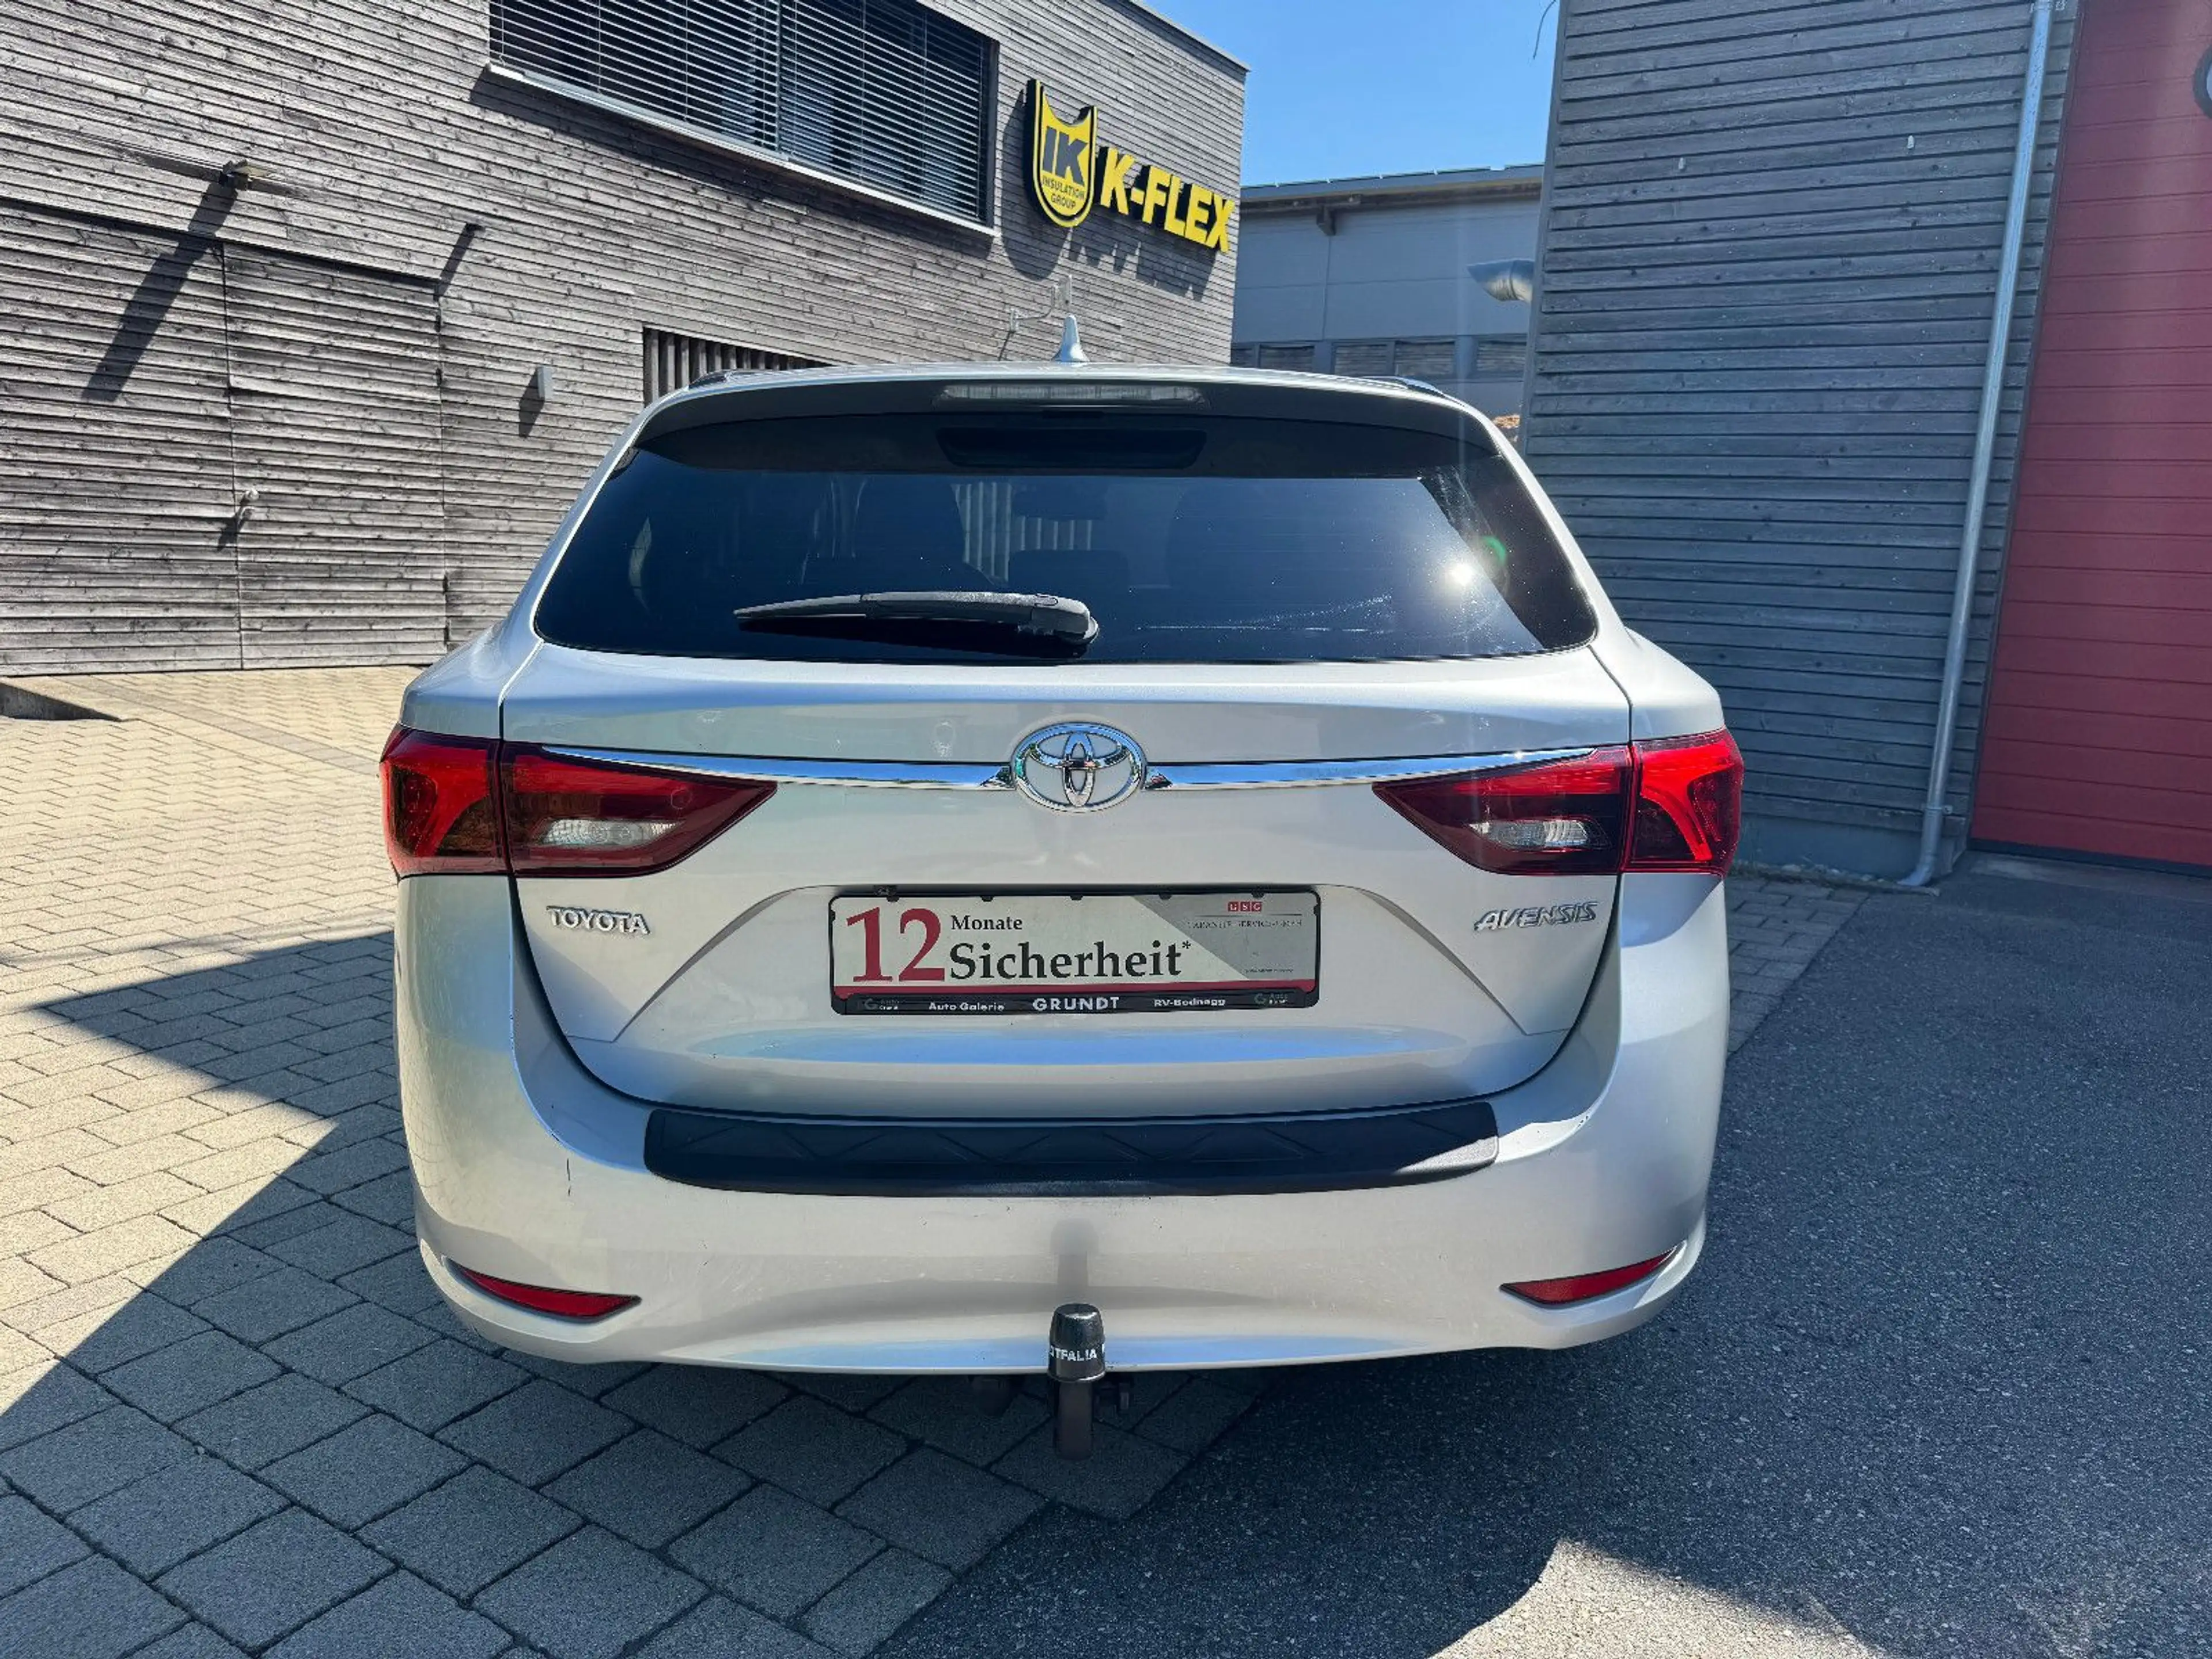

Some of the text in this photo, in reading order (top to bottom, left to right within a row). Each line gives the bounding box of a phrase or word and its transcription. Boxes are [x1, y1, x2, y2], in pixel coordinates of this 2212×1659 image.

[1041, 175, 1085, 200] INSULATION
[1100, 147, 1236, 253] K-FLEX
[1051, 193, 1076, 209] GROUP
[546, 906, 650, 934] TOYOTA
[951, 915, 1022, 930] Monate
[1474, 902, 1599, 931] AVENSIS
[846, 907, 945, 982] 12
[929, 1002, 1005, 1011] Auto Galerie
[1032, 997, 1119, 1011] GRUNDT
